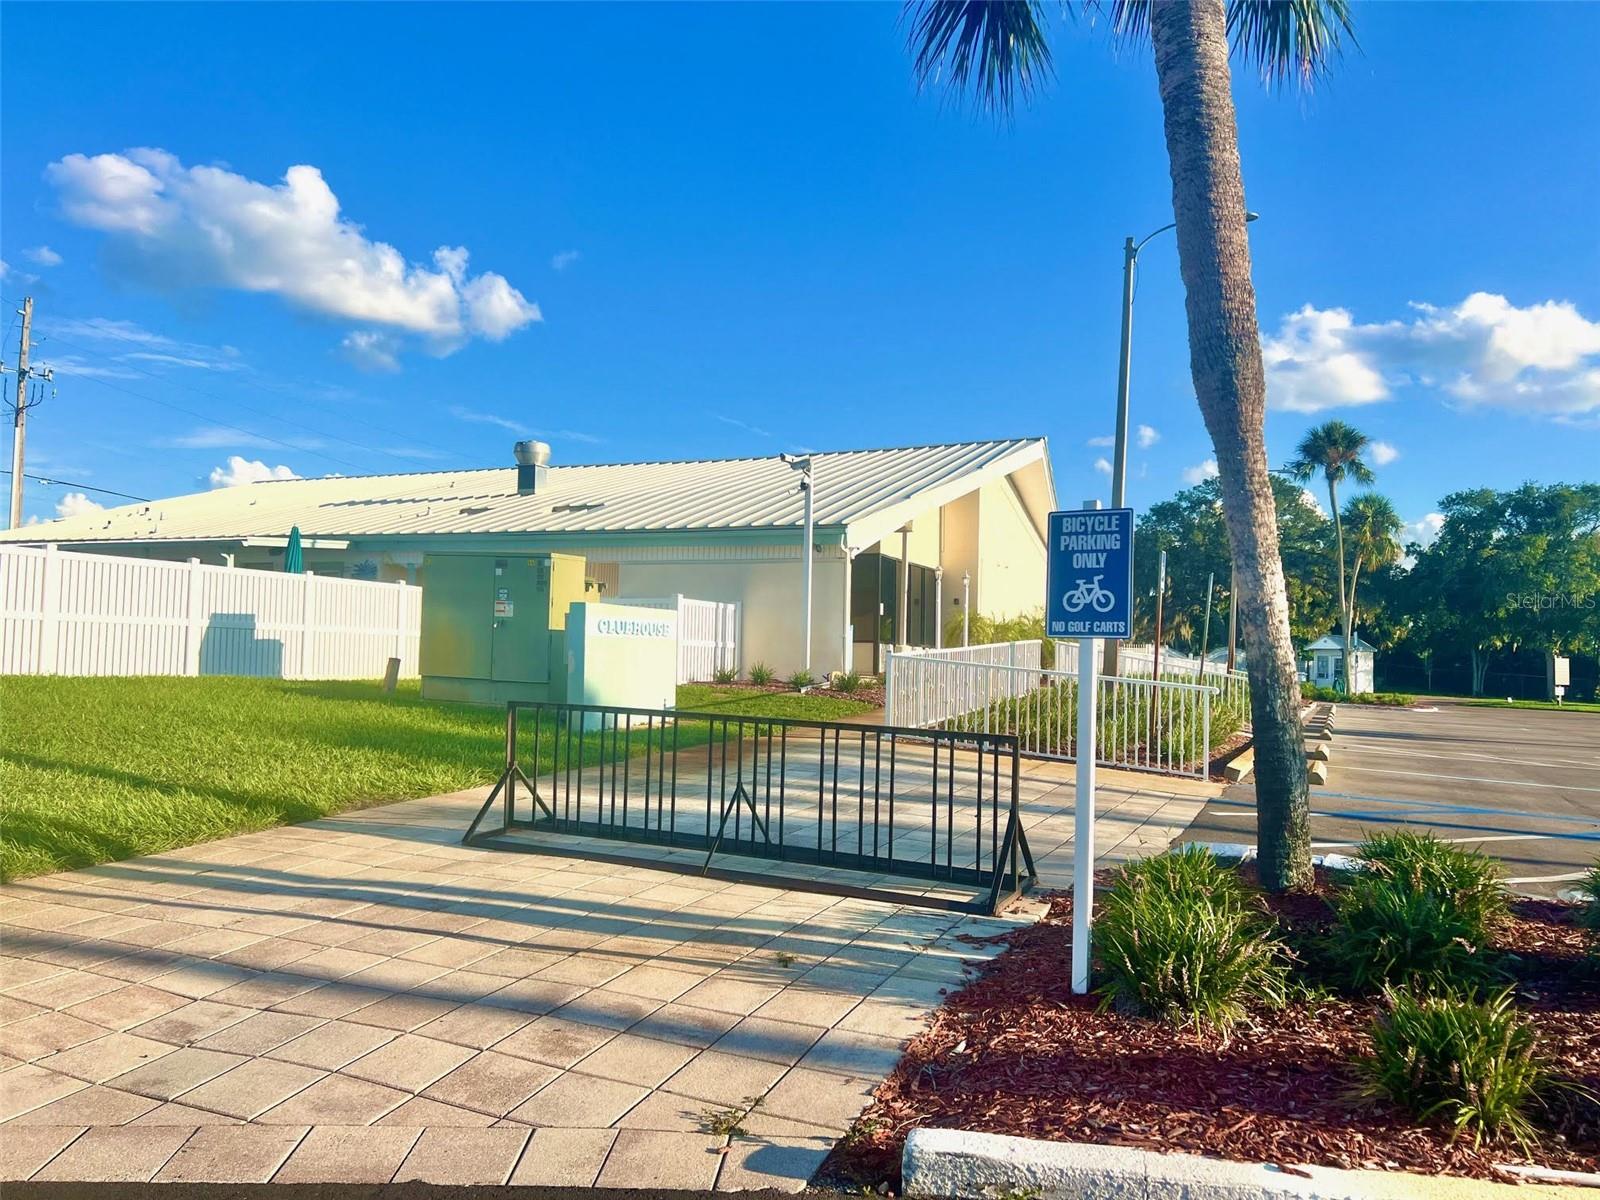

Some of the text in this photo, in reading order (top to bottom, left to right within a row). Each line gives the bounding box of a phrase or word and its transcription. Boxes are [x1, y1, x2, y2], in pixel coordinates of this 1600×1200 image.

[1062, 515, 1119, 534] BICYCLE
[1060, 534, 1121, 551] PARKING
[1072, 552, 1108, 569] ONLY
[597, 619, 671, 637] CLUBHOUSE
[1051, 621, 1126, 633] NO GOLF CARTS
